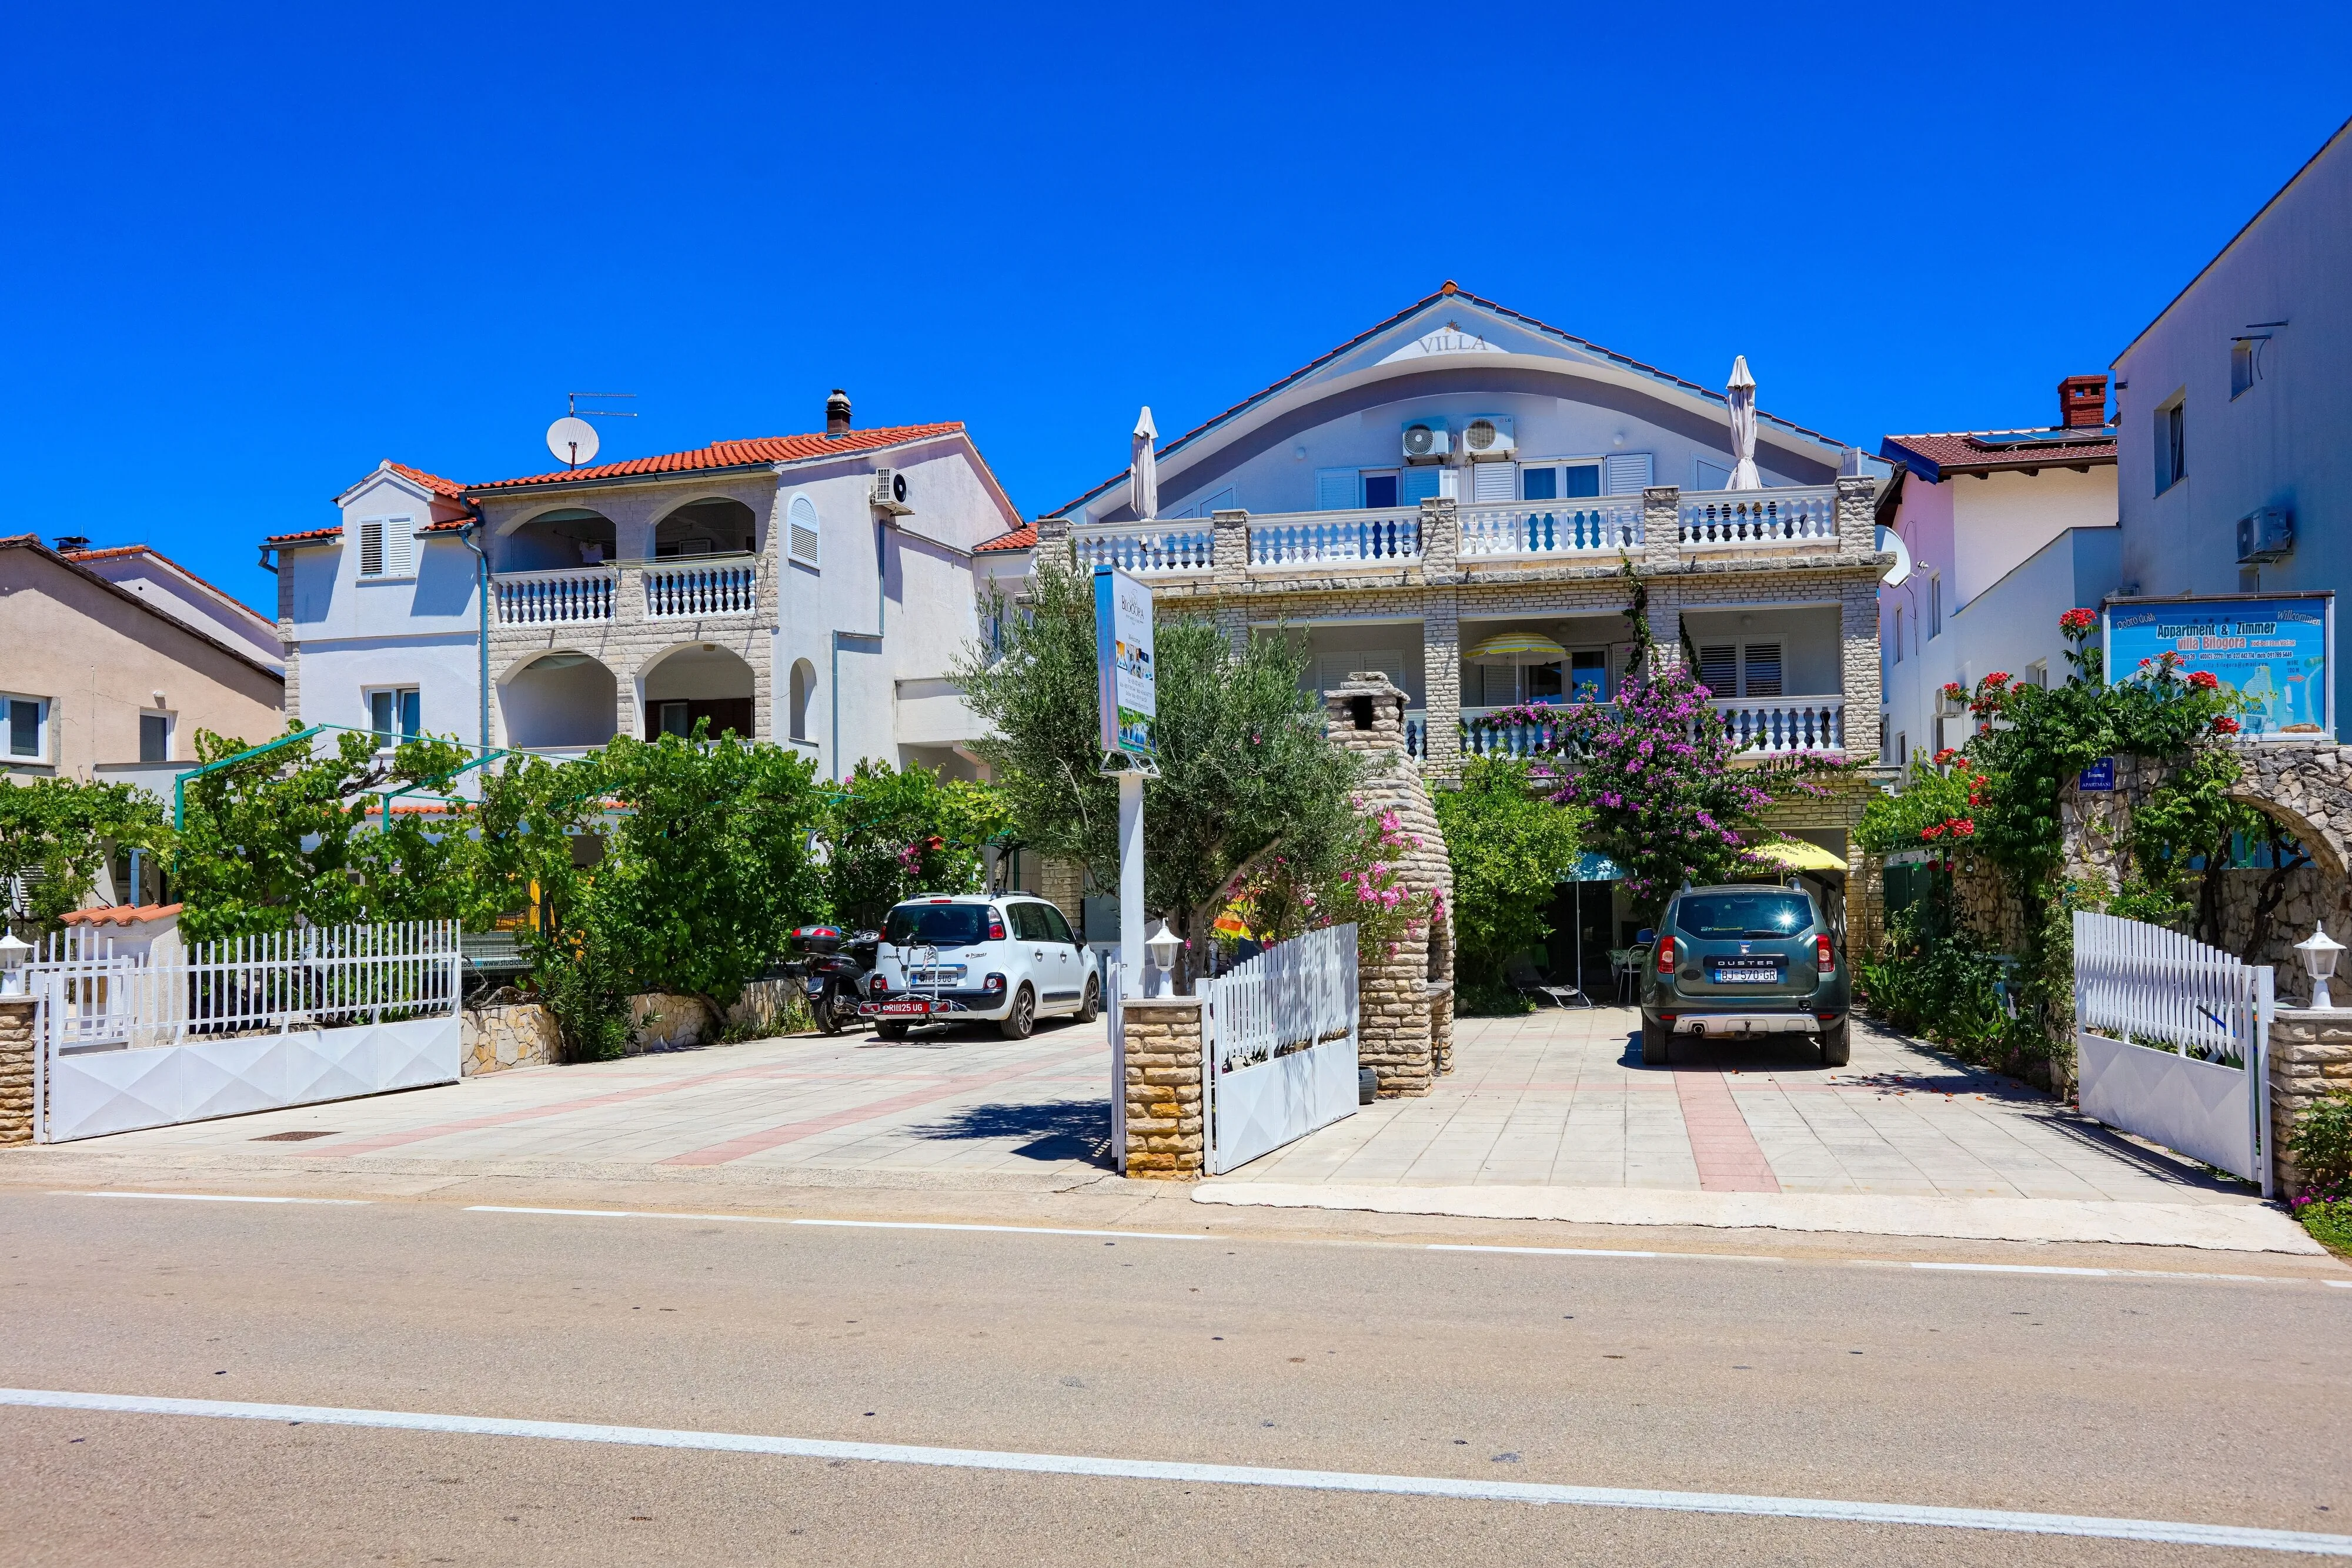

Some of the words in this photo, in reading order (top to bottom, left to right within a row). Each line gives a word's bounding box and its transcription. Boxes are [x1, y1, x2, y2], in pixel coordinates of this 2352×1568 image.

[1418, 335, 1488, 353] VILLA
[2117, 616, 2138, 630] Dobro
[2277, 609, 2321, 626] Willcommen
[2157, 624, 2216, 638] Appartment
[2220, 624, 2229, 636] &
[2236, 621, 2276, 635] Zimmer
[2177, 637, 2199, 650] villa
[2203, 636, 2246, 650] Bilogora
[1722, 970, 1733, 980] BJ
[889, 1004, 896, 1012] RI
[901, 1004, 911, 1012] 25
